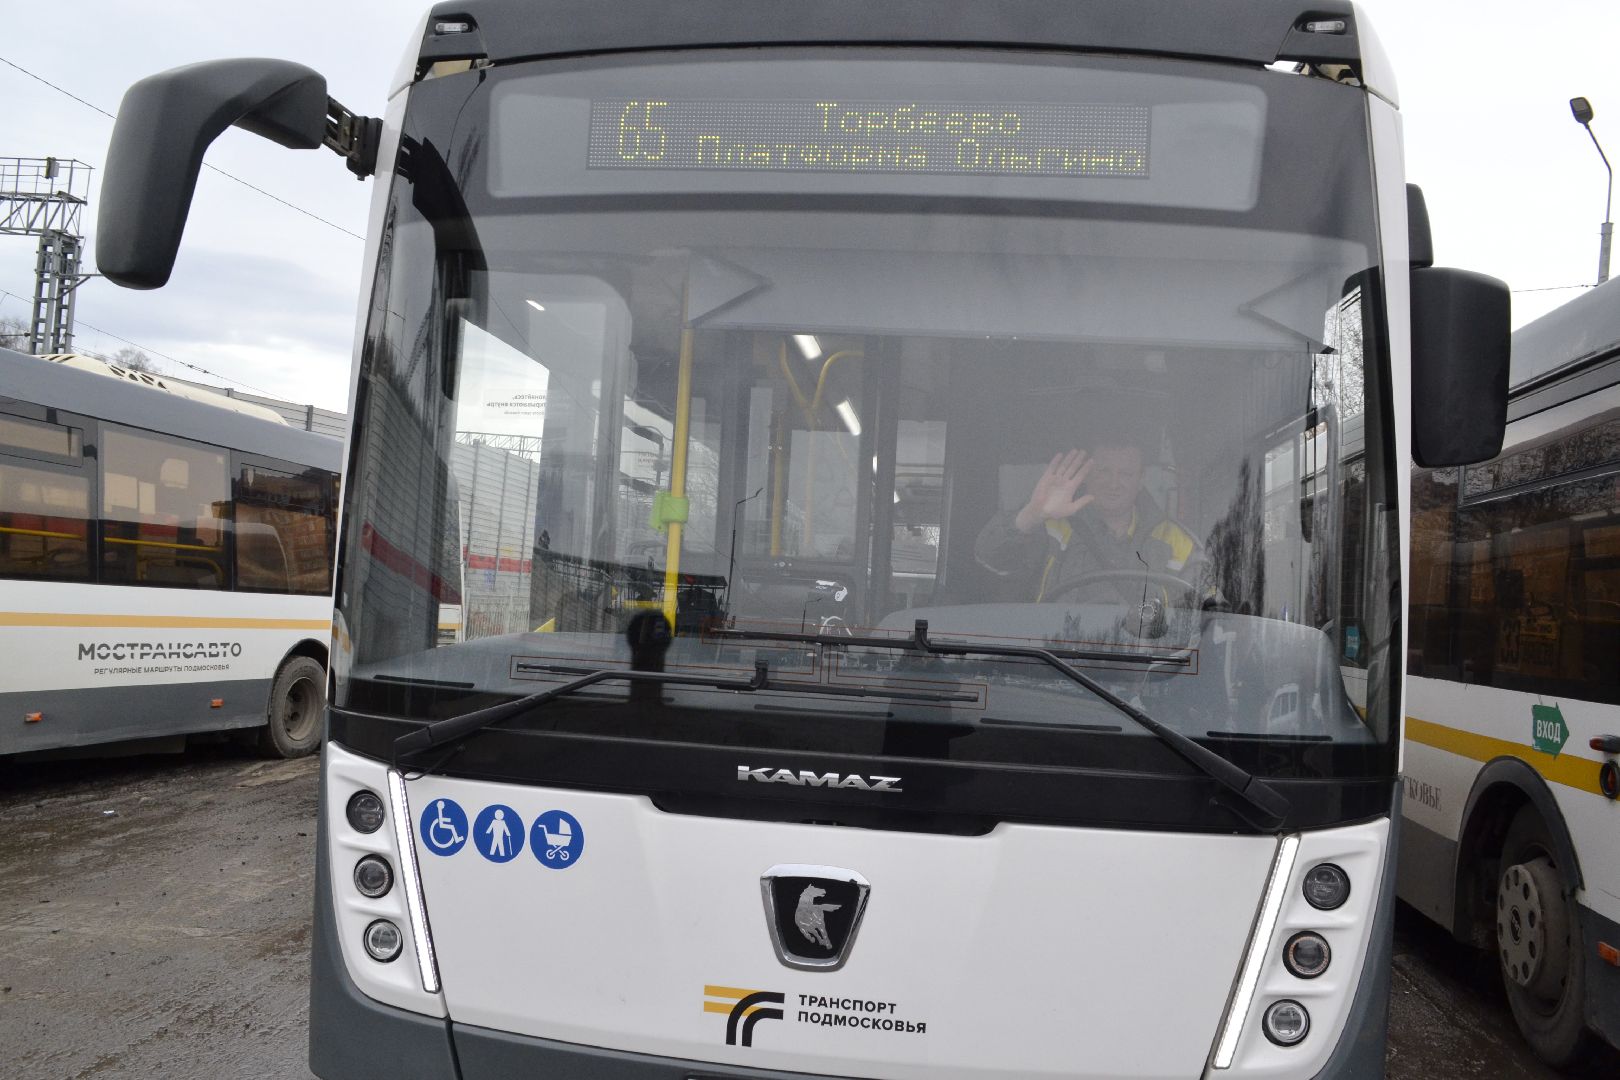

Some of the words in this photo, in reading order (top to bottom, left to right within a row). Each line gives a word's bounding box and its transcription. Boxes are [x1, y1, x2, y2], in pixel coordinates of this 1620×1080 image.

[618, 101, 669, 160] 65
[815, 101, 1021, 136] Торбеево
[697, 134, 928, 172] Платформа
[955, 137, 1143, 174] Ольгино
[77, 642, 242, 660] МОСТРАНСАВТО
[94, 666, 142, 675] РЕГУЛЯРНЫЕ
[143, 665, 183, 673] МАРШРУТЫ
[184, 664, 230, 672] ПОДМОСКОВЬЯ
[1536, 719, 1561, 744] ВХОД
[737, 765, 903, 793] KAMAZ
[798, 994, 896, 1014] ТРАНСПОРТ
[798, 1011, 927, 1034] ПОДМОСКОВЬЯ
